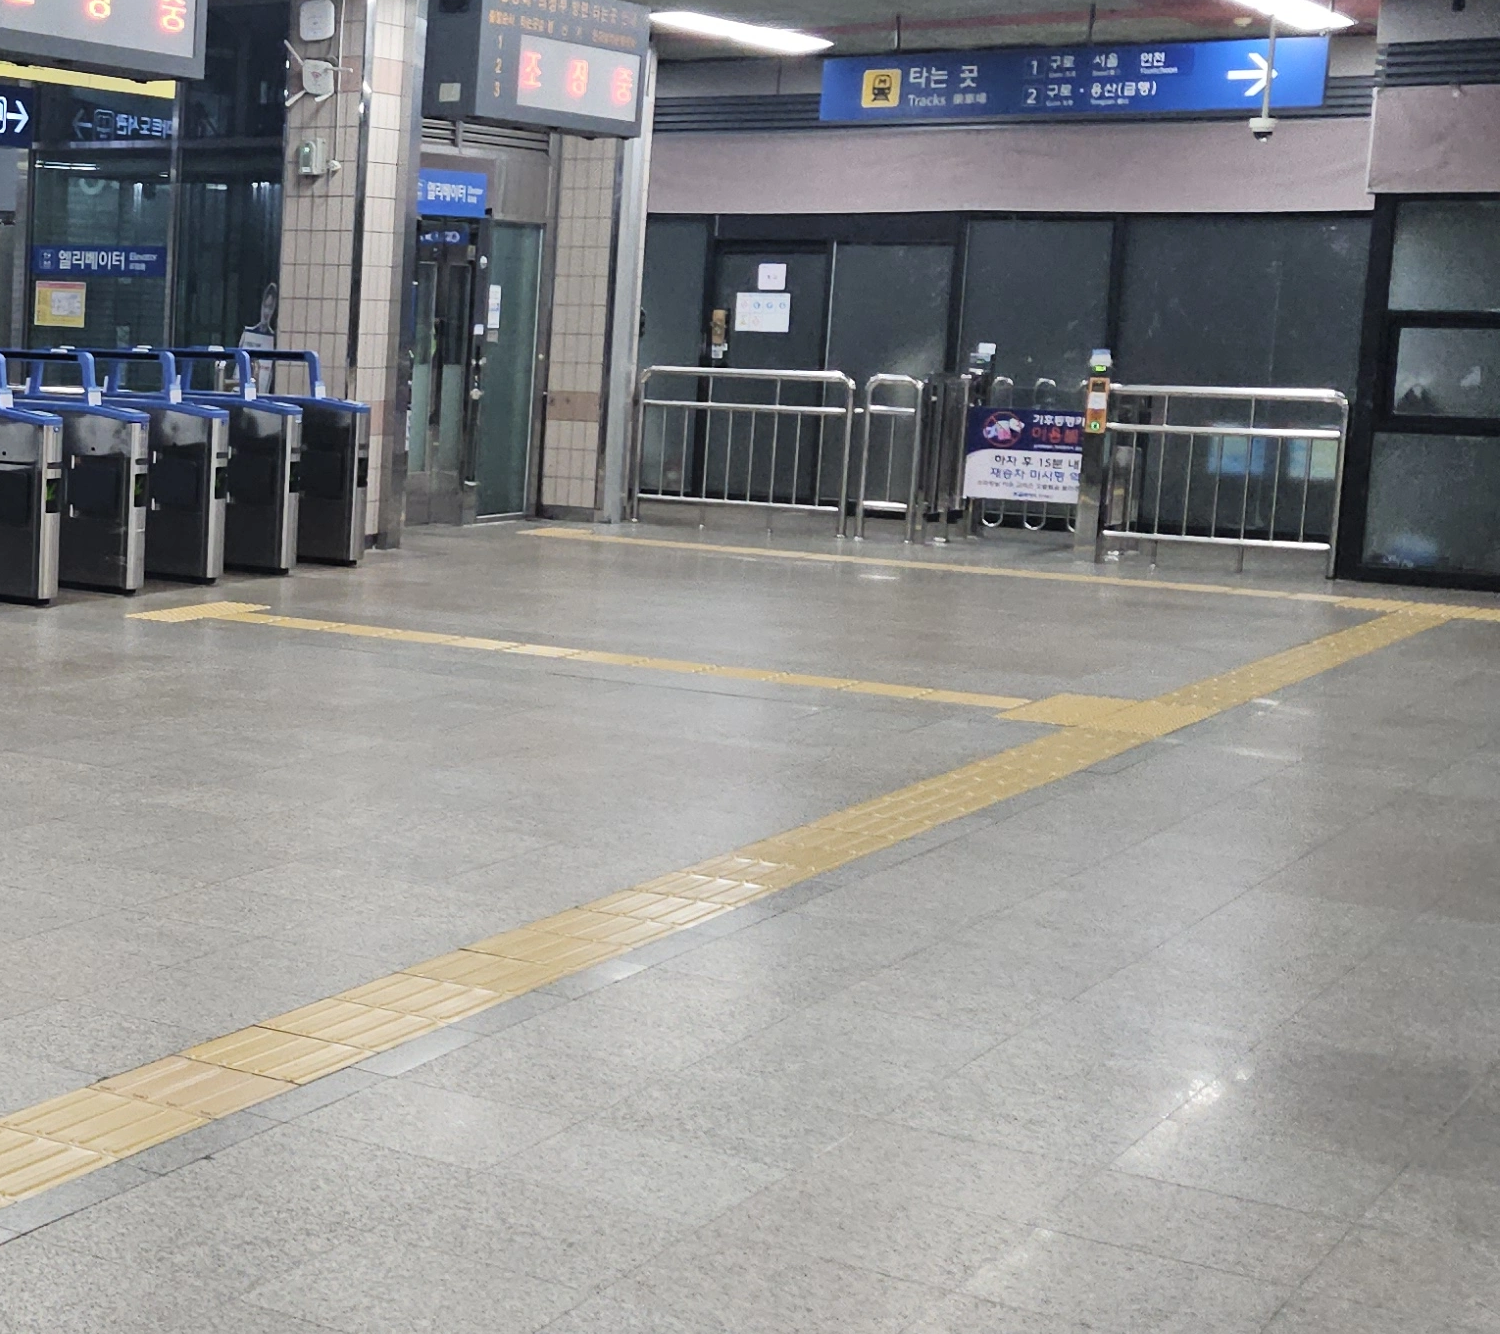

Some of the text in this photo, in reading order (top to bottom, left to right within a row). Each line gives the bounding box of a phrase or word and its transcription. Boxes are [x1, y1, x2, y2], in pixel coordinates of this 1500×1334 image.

[1030, 60, 1038, 76] 1
[909, 65, 978, 88] 타는 곳
[907, 94, 947, 106] Tracks
[1026, 88, 1037, 104] 2
[59, 250, 125, 271] 엘리베이터
